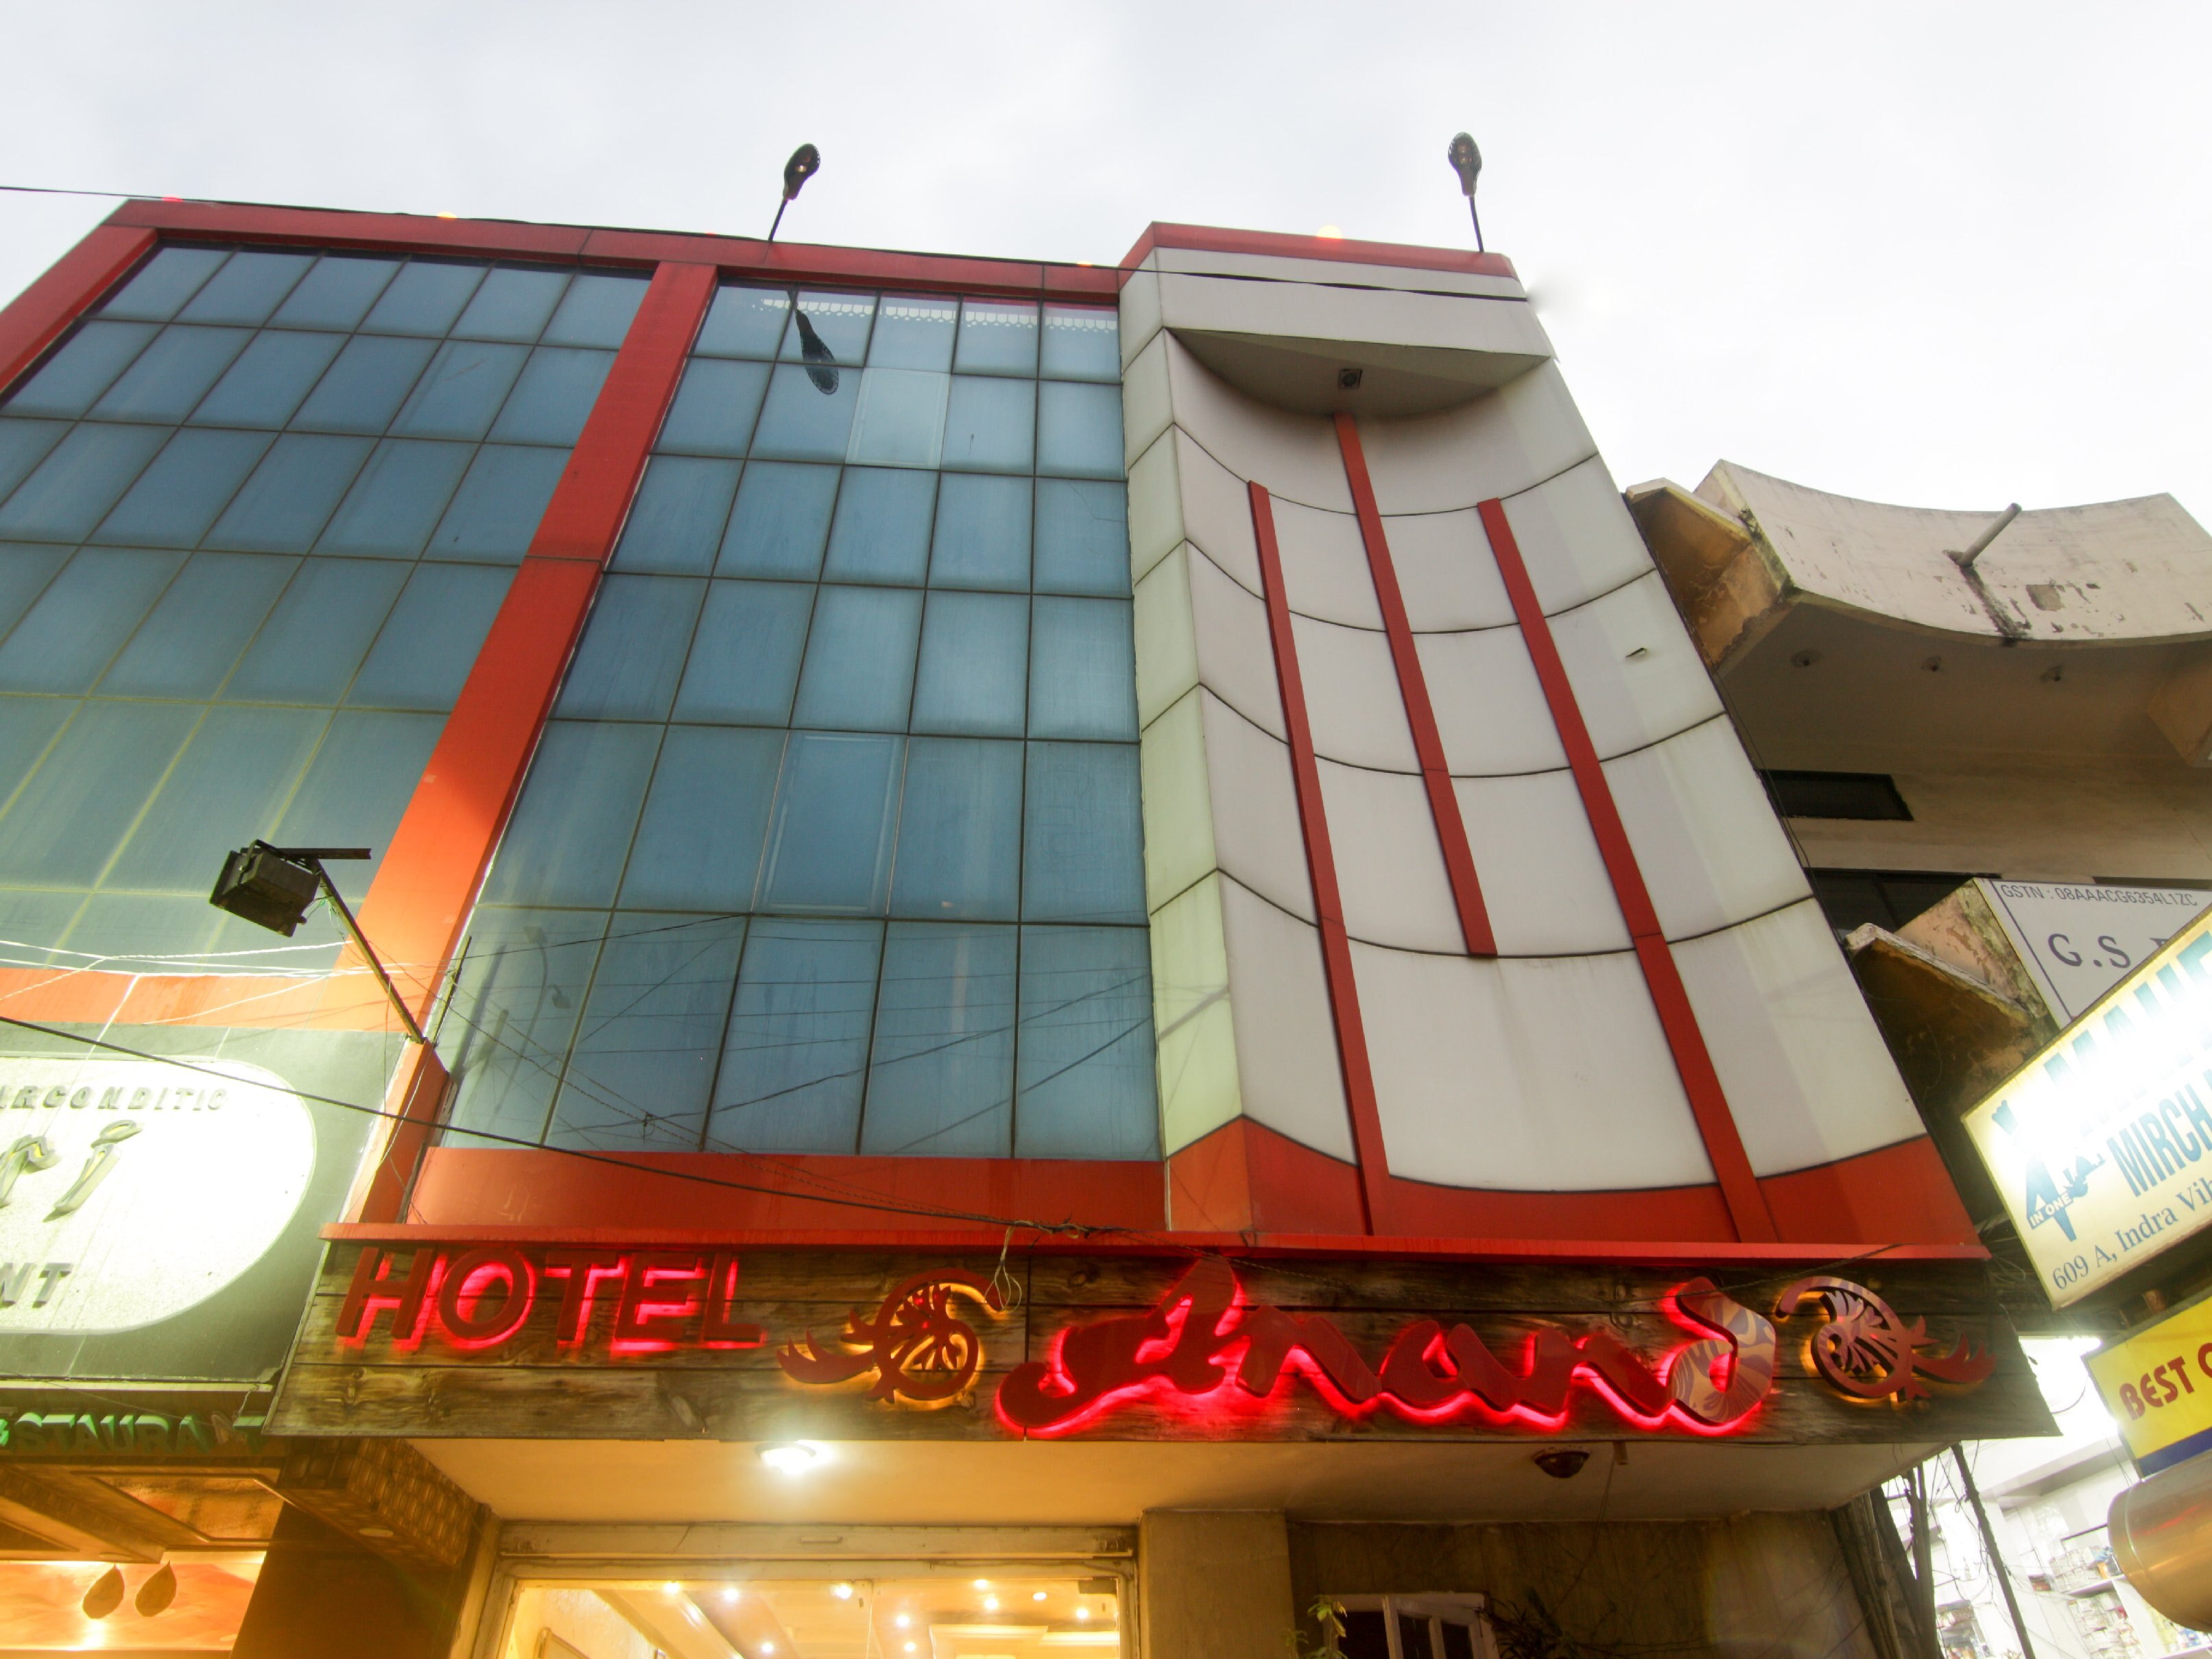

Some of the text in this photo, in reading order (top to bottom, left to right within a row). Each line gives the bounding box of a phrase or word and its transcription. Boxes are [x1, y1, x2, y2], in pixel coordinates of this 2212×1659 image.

[2001, 884, 2044, 899] GSTN
[2030, 1193, 2071, 1226] IN ONE
[2052, 1255, 2089, 1289] 609
[2115, 1207, 2178, 1252] Indra
[334, 1247, 767, 1344] HOTEL
[2119, 1355, 2195, 1421] BEST
